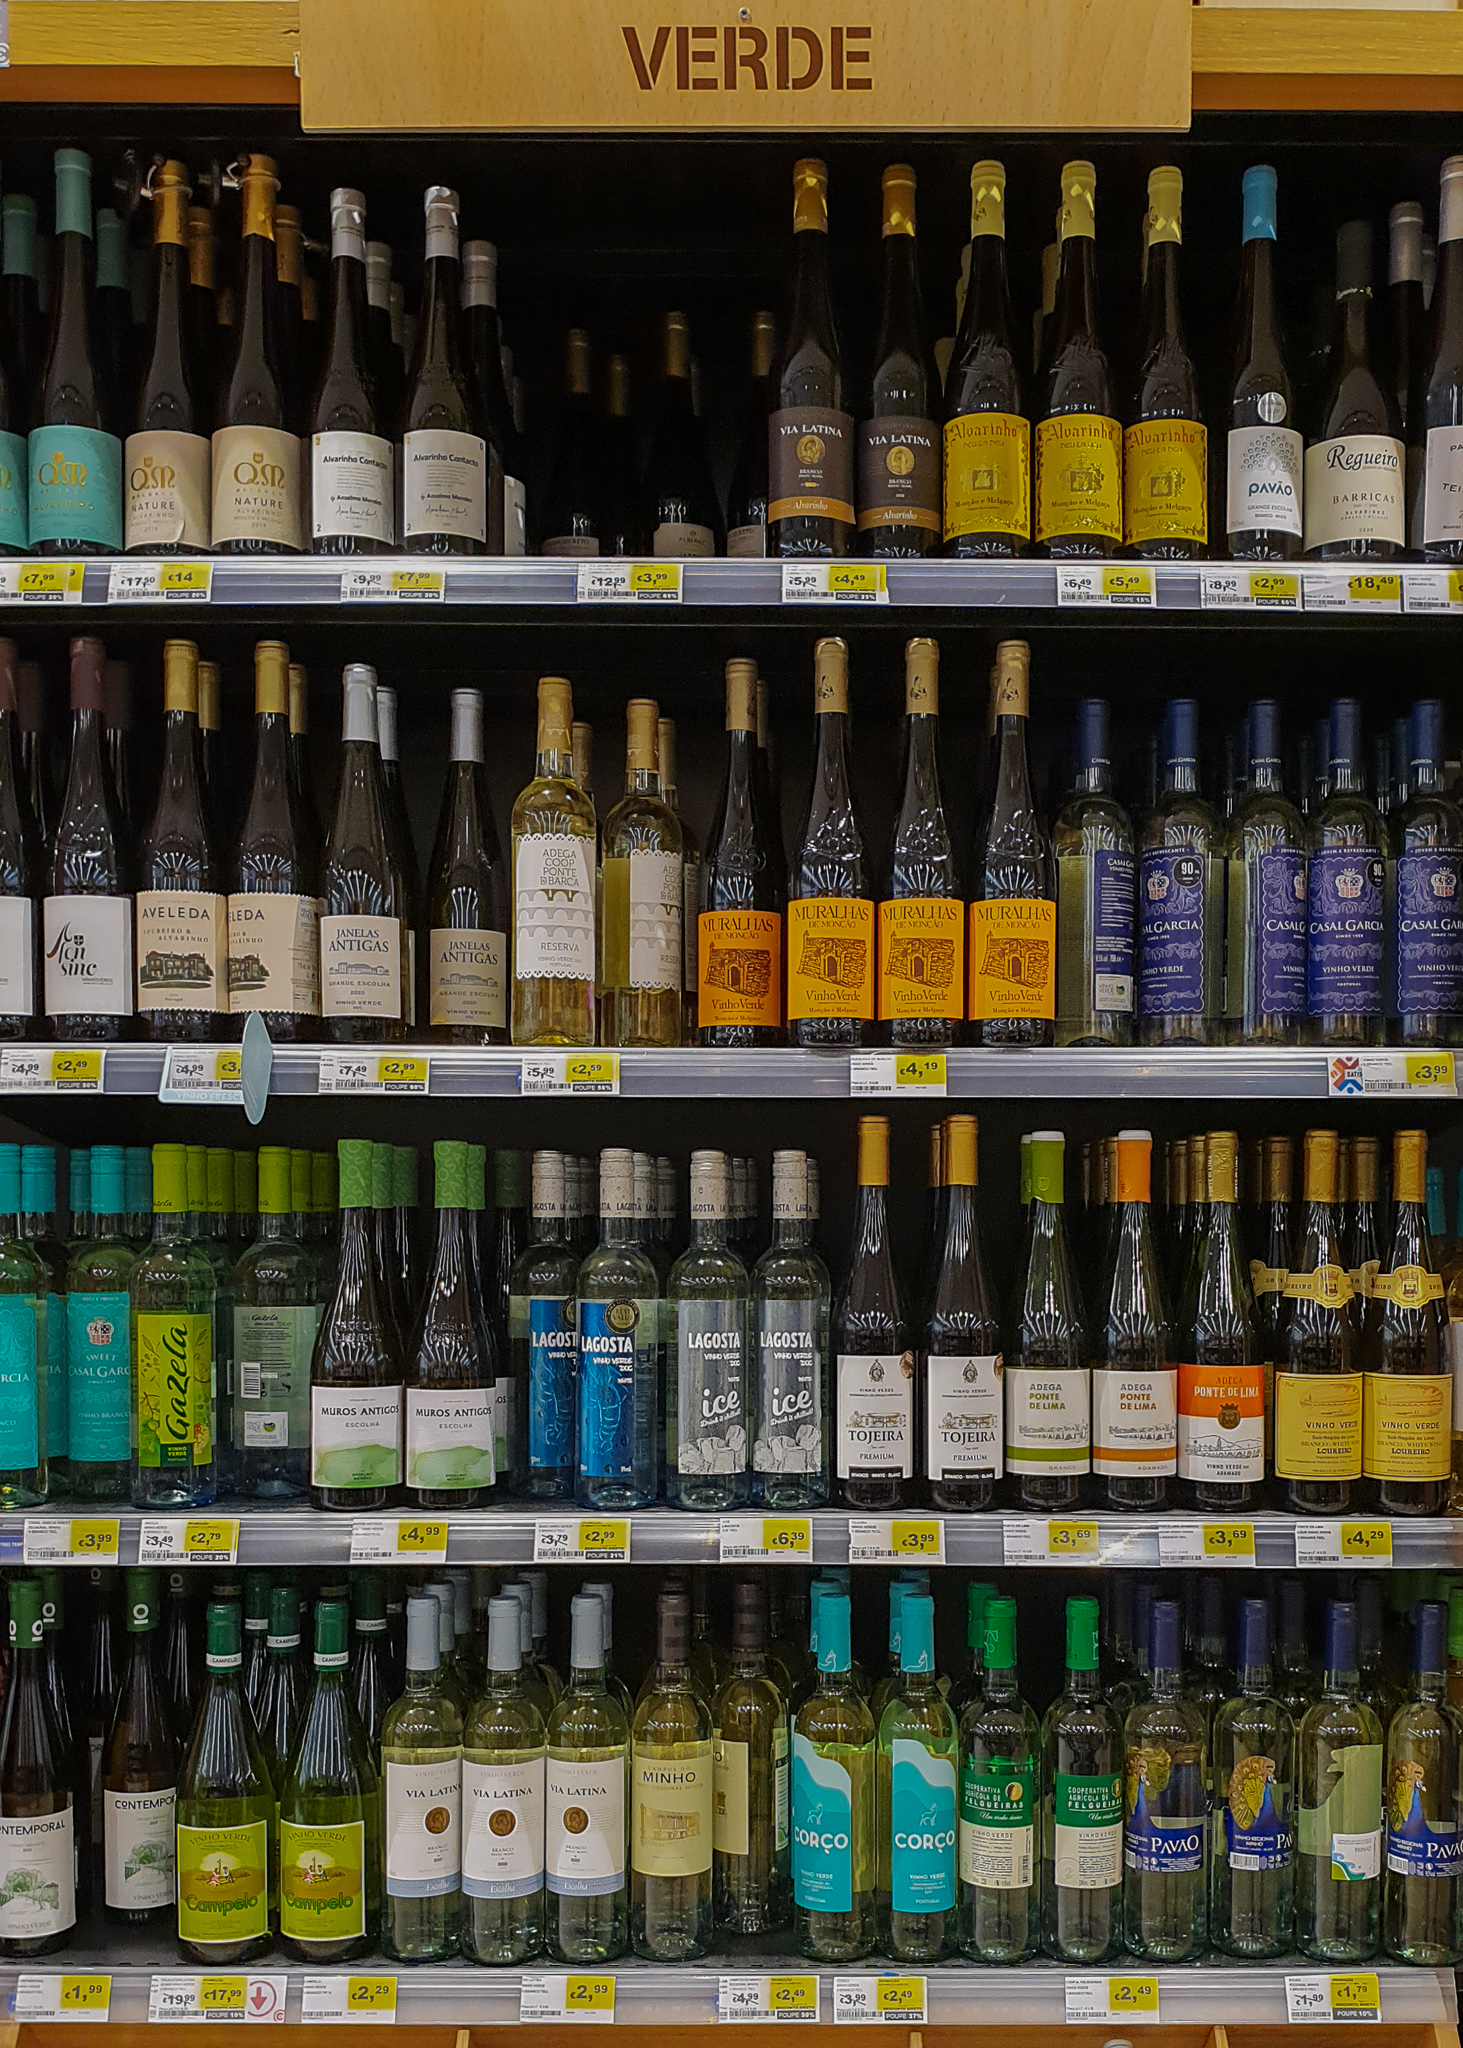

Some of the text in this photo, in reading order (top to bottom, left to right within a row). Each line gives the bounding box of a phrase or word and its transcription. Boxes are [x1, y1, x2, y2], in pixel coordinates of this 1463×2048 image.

[622, 27, 872, 90] VERDE
[780, 425, 842, 438] VIA LATINA
[869, 435, 931, 447] VIA LATINA
[323, 455, 387, 470] Alvarinho Contacto
[413, 454, 478, 467] Alvarinho Contacto
[1327, 444, 1398, 471] Regueiro
[235, 497, 284, 509] NATURE
[1333, 493, 1395, 504] BARRICAS
[132, 501, 175, 511] NATURE
[882, 511, 917, 520] Alvarinho
[24, 574, 54, 592] €7,99
[168, 572, 193, 582] €14
[835, 574, 865, 586] €4,49
[1110, 577, 1139, 588] €5,49
[1255, 578, 1285, 591] €2,99
[1348, 576, 1394, 592] €18,49
[542, 849, 576, 859] ADEGA
[544, 858, 574, 868] COOP
[1181, 863, 1194, 875] 90
[543, 867, 577, 877] PONTE
[548, 876, 579, 886] BARCA
[142, 907, 211, 921] AVELEDA
[795, 906, 869, 921] MURALHAS
[883, 906, 958, 921] MURALHAS
[978, 906, 1052, 921] MURALHAS
[703, 917, 774, 932] MURALHAS
[822, 919, 856, 929] MONÇÃO
[1266, 920, 1295, 932] CASAL
[1310, 919, 1384, 933] CASAL GARCIA
[158, 935, 208, 943] ALVARINHO
[336, 929, 379, 939] JANELAS
[328, 939, 389, 953] ANTIGAS
[449, 941, 490, 951] JANELAS
[540, 942, 579, 951] RESERVA
[440, 952, 498, 966] ANTIGAS
[806, 991, 861, 1002] Vinho Verde
[893, 991, 948, 1002] Vinho Verde
[990, 991, 1045, 1002] Vinho Verde
[711, 999, 765, 1010] Vinho Verde
[57, 1060, 87, 1073] €2,49
[385, 1064, 415, 1076] €2,99
[572, 1064, 602, 1076] €2,59
[900, 1062, 938, 1078] €4,19
[1415, 1065, 1448, 1083] €3,99
[177, 1092, 206, 1100] VINHO
[581, 1336, 633, 1353] LAGOSTA
[688, 1332, 740, 1349] LAGOSTA
[760, 1332, 812, 1348] LAGOSTA
[86, 1354, 117, 1362] SWEET
[163, 1323, 188, 1441] Gazela
[1216, 1376, 1243, 1384] ADEGA
[1029, 1383, 1062, 1391] ADEGA
[1120, 1383, 1153, 1391] ADEGA
[1194, 1386, 1259, 1398] PONTE DE LIMA
[702, 1388, 740, 1416] ice
[772, 1387, 812, 1416] ice
[1029, 1393, 1060, 1401] PONTE
[1120, 1393, 1151, 1401] PONTE
[321, 1405, 400, 1415] MUROS ANTIGOS
[415, 1407, 492, 1417] MUROS ANTIGOS
[1029, 1402, 1066, 1410] DE LIMA
[1120, 1402, 1157, 1410] DE LIMA
[1306, 1420, 1358, 1429] VINHO VERDE
[1381, 1421, 1440, 1429] VINHO VERDE
[848, 1429, 904, 1445] TOJEIRA
[941, 1430, 996, 1445] TOJEIRA
[1316, 1447, 1352, 1455] LOUREIRO
[1391, 1447, 1430, 1456] LOUREIRO
[191, 1533, 221, 1546] €2,79
[402, 1527, 439, 1543] €4,99
[585, 1531, 615, 1544] €2,99
[772, 1531, 805, 1548] €6,39
[902, 1533, 935, 1549] €3,99
[1053, 1530, 1091, 1547] €3,69
[1209, 1530, 1246, 1547] €3,69
[1347, 1530, 1384, 1548] €4,29
[78, 1534, 112, 1550] €3,99
[643, 1771, 696, 1784] MINHO
[406, 1783, 461, 1799] VIA LATINA
[473, 1787, 533, 1799] VIA LATINA
[550, 1785, 607, 1796] VIA LATINA
[965, 1781, 1001, 1794] COOPERATIVA
[1067, 1786, 1108, 1794] COOPERATIVA
[965, 1796, 1024, 1810] FELGUEIRAS
[795, 1826, 848, 1854] CORÇO
[895, 1829, 955, 1853] CORÇO
[1150, 1833, 1199, 1854] PAVÃO
[186, 1892, 258, 1917] Campelo
[285, 1889, 354, 1915] Campelo
[65, 1984, 103, 2003] €1,99
[204, 1988, 242, 2004] €17,99
[352, 1984, 389, 2002] €2,29
[571, 1984, 608, 2003] €2,99
[776, 1989, 805, 2002] €2,49
[883, 1990, 912, 2004] €2,49
[1115, 1985, 1152, 2004] €2,49
[1337, 1984, 1367, 1999] €1,79
